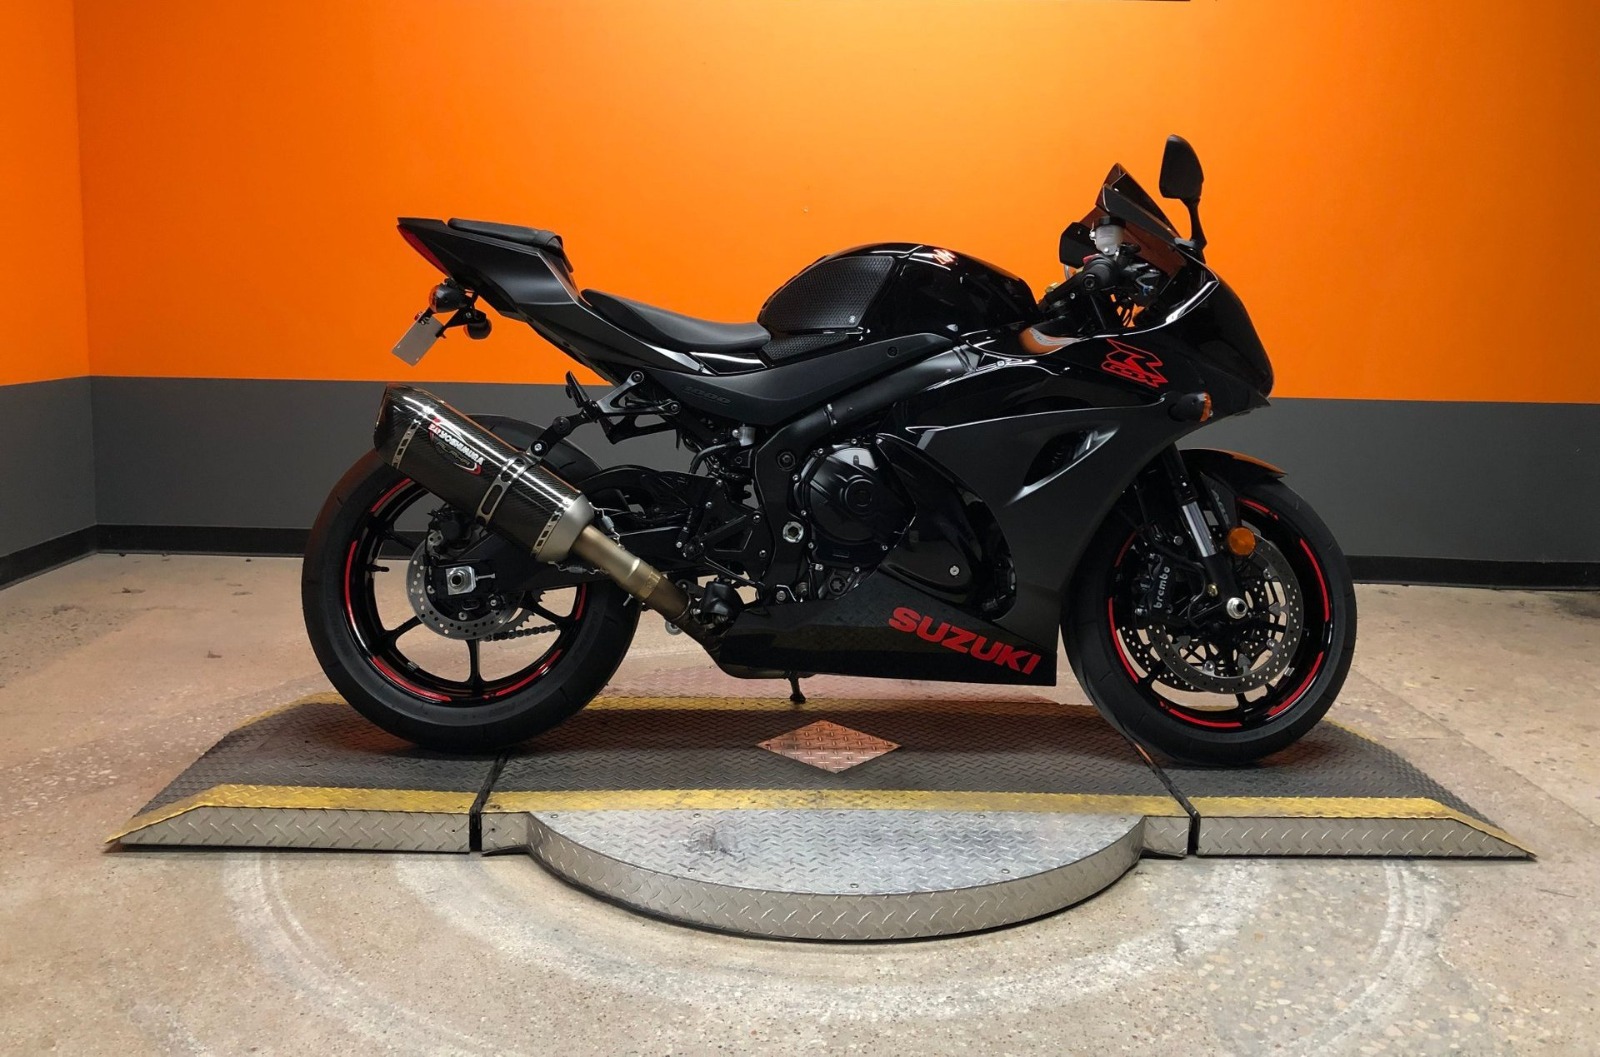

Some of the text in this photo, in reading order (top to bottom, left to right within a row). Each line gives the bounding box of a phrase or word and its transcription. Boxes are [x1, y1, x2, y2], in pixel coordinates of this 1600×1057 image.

[438, 430, 486, 466] YOSHIMURA
[1153, 566, 1170, 609] brembo
[888, 606, 1041, 675] SUZUKI
